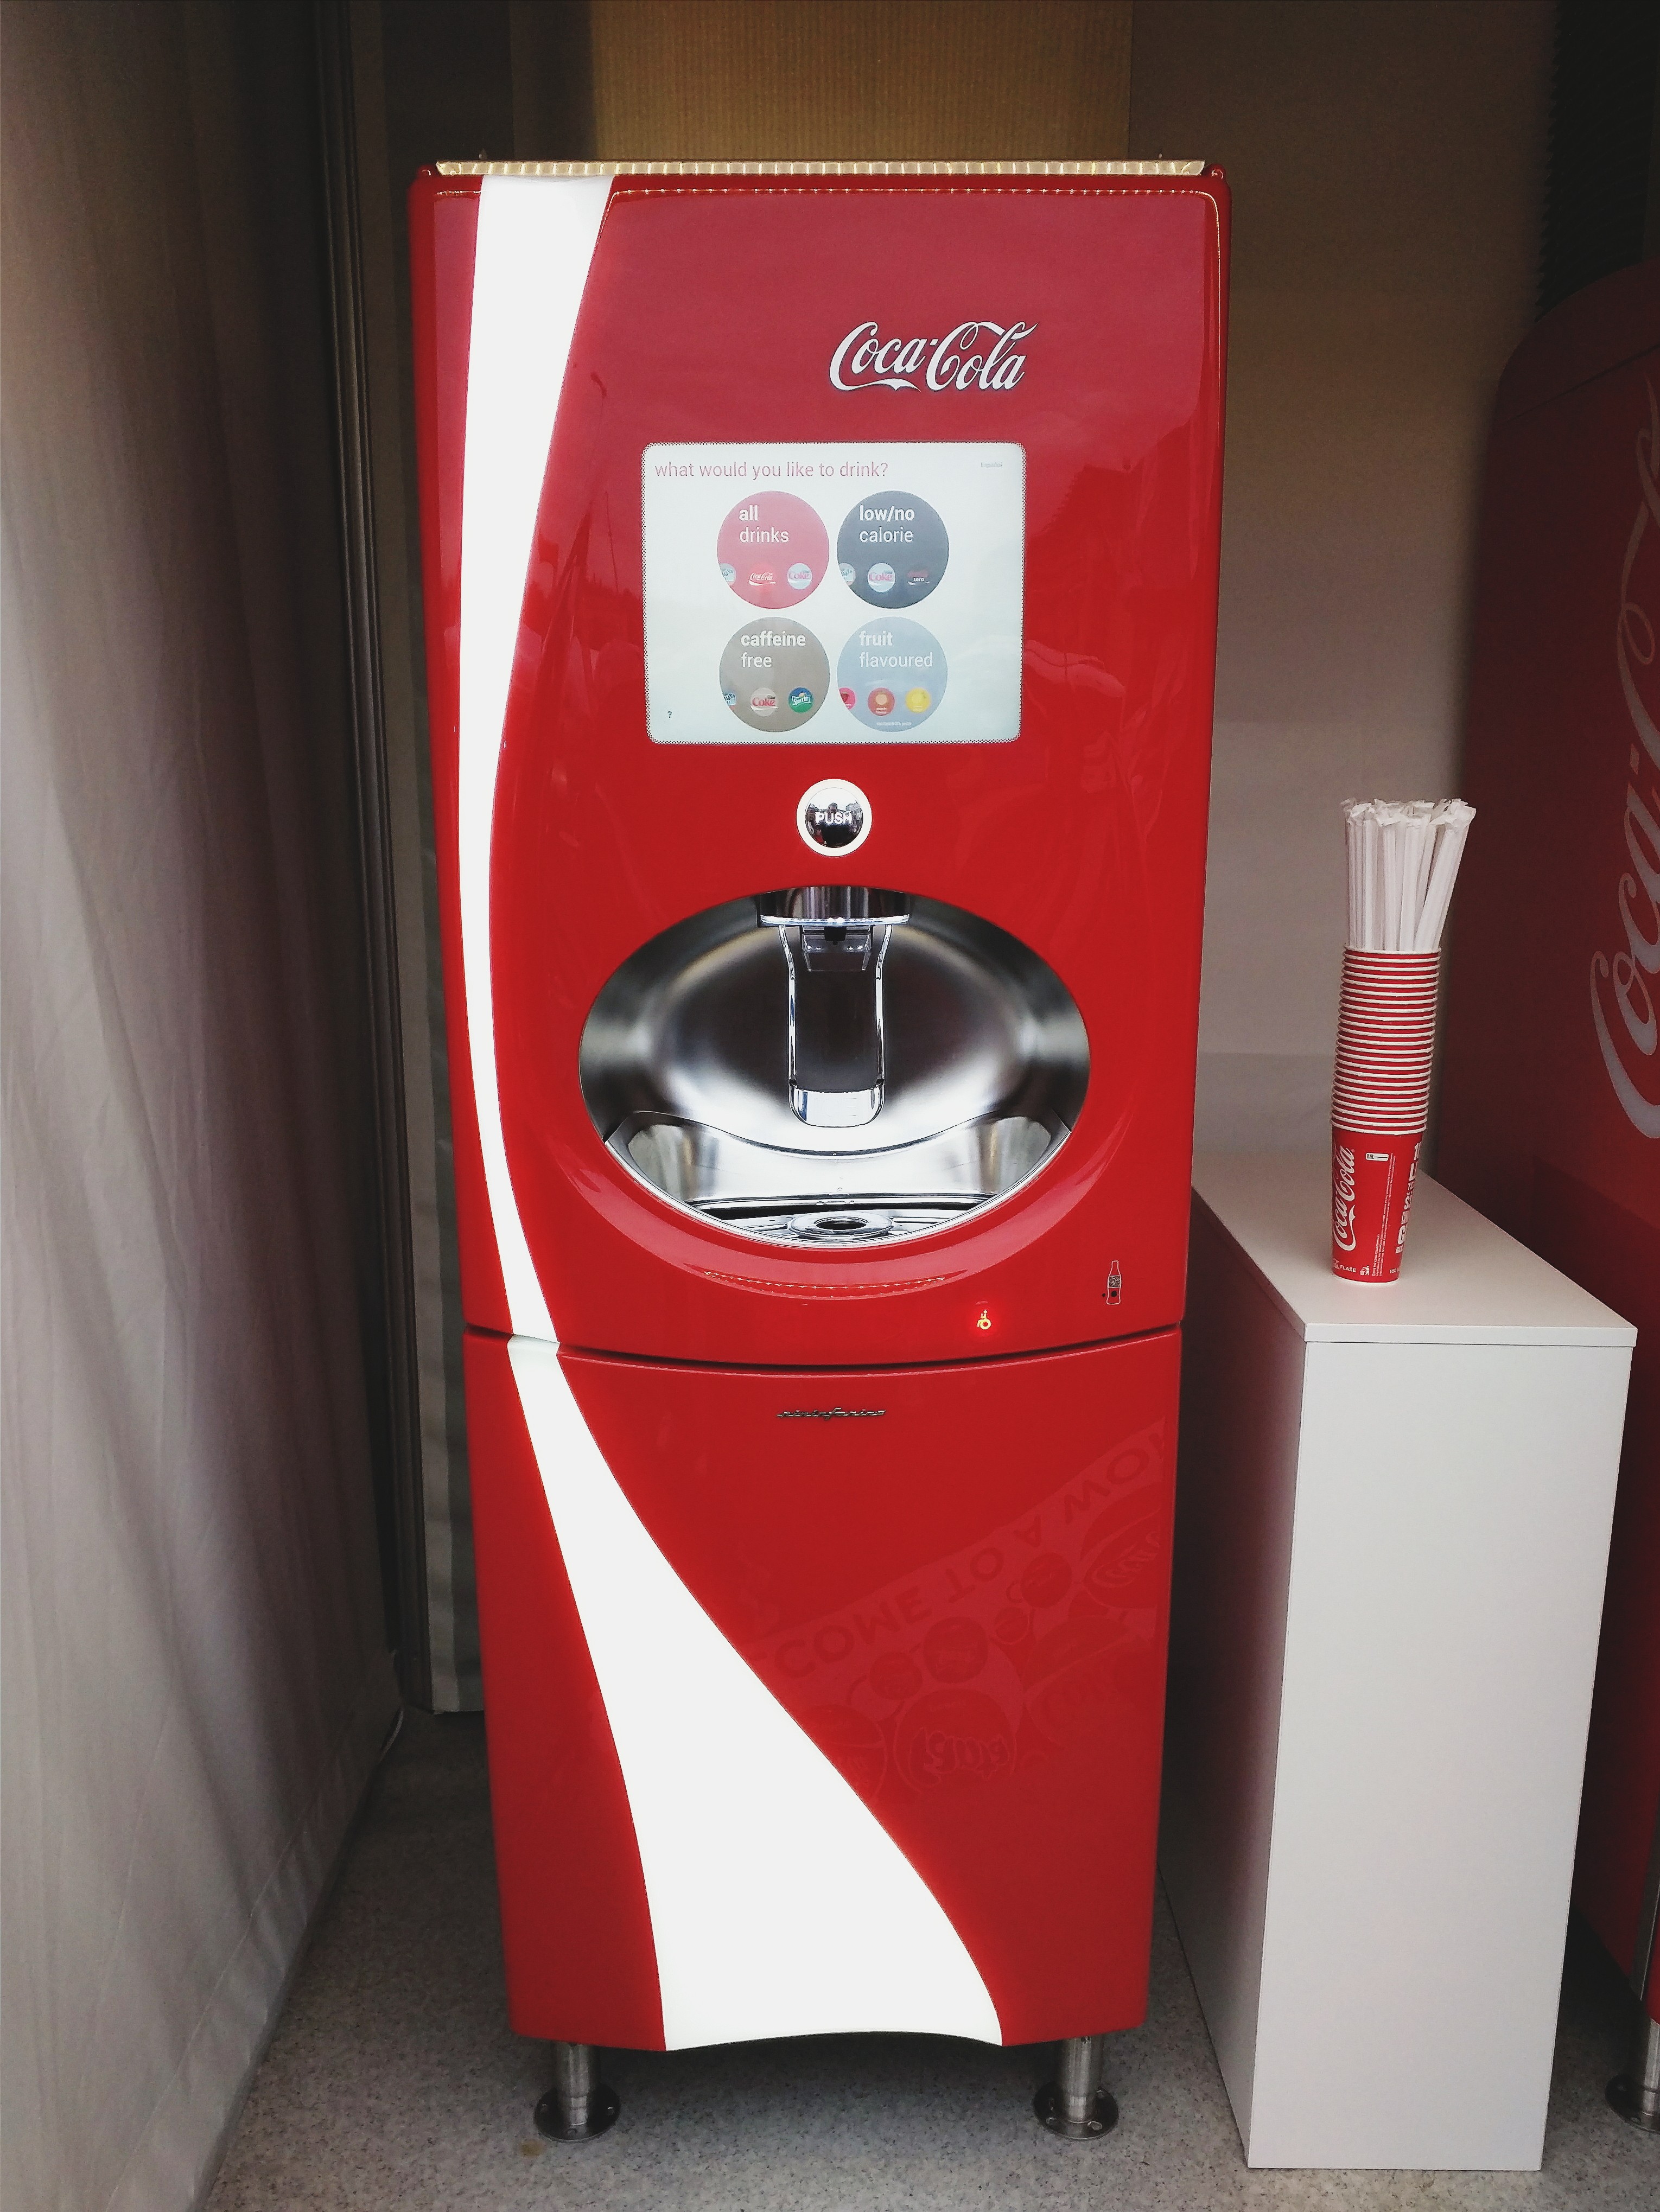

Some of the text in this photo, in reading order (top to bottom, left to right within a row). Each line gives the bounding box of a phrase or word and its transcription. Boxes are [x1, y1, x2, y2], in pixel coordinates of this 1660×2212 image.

[829, 321, 1038, 392] Coca-Cola
[655, 461, 888, 480] what would you like to drink?
[739, 505, 759, 521] all
[859, 505, 915, 522] low/no
[739, 526, 790, 543] drinks
[859, 526, 914, 543] calorie
[869, 573, 893, 582] Coke
[740, 630, 806, 647] caffeine
[858, 630, 893, 646] fruit
[741, 652, 772, 668] free
[858, 652, 933, 668] flavoured
[752, 697, 775, 706] Coke
[792, 695, 812, 706] Sprite
[815, 811, 853, 825] PUSH
[1332, 1143, 1356, 1251] Coca-Cola
